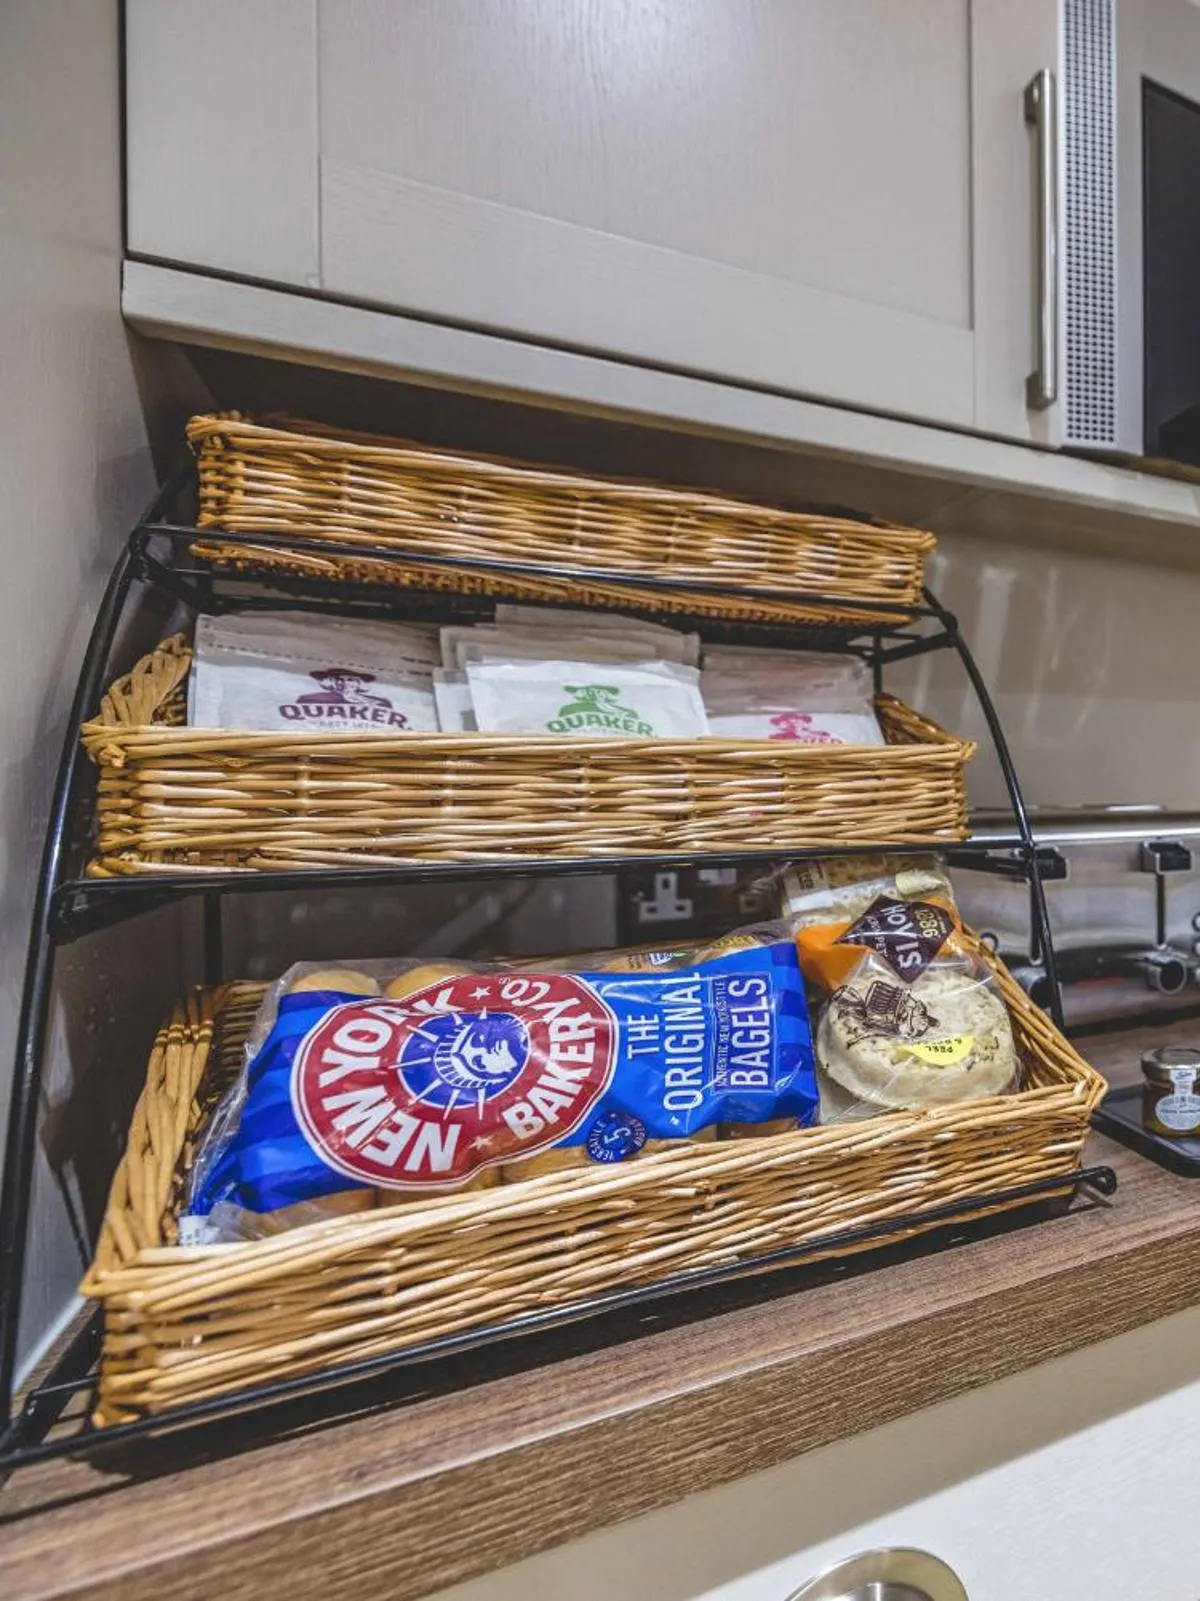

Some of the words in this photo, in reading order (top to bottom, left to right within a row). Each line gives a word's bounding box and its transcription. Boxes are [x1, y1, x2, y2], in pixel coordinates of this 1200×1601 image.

[278, 703, 408, 730] QUAKER
[547, 713, 654, 736] QUAKER
[879, 903, 923, 970] HOVIS
[318, 986, 466, 1089] YORK
[502, 997, 597, 1140] BAKERY
[626, 1013, 660, 1060] THE
[662, 971, 706, 1111] ORIGINAL
[727, 977, 771, 1087] BAGELS
[320, 1085, 463, 1173] NEW
[603, 1126, 632, 1145] 5
